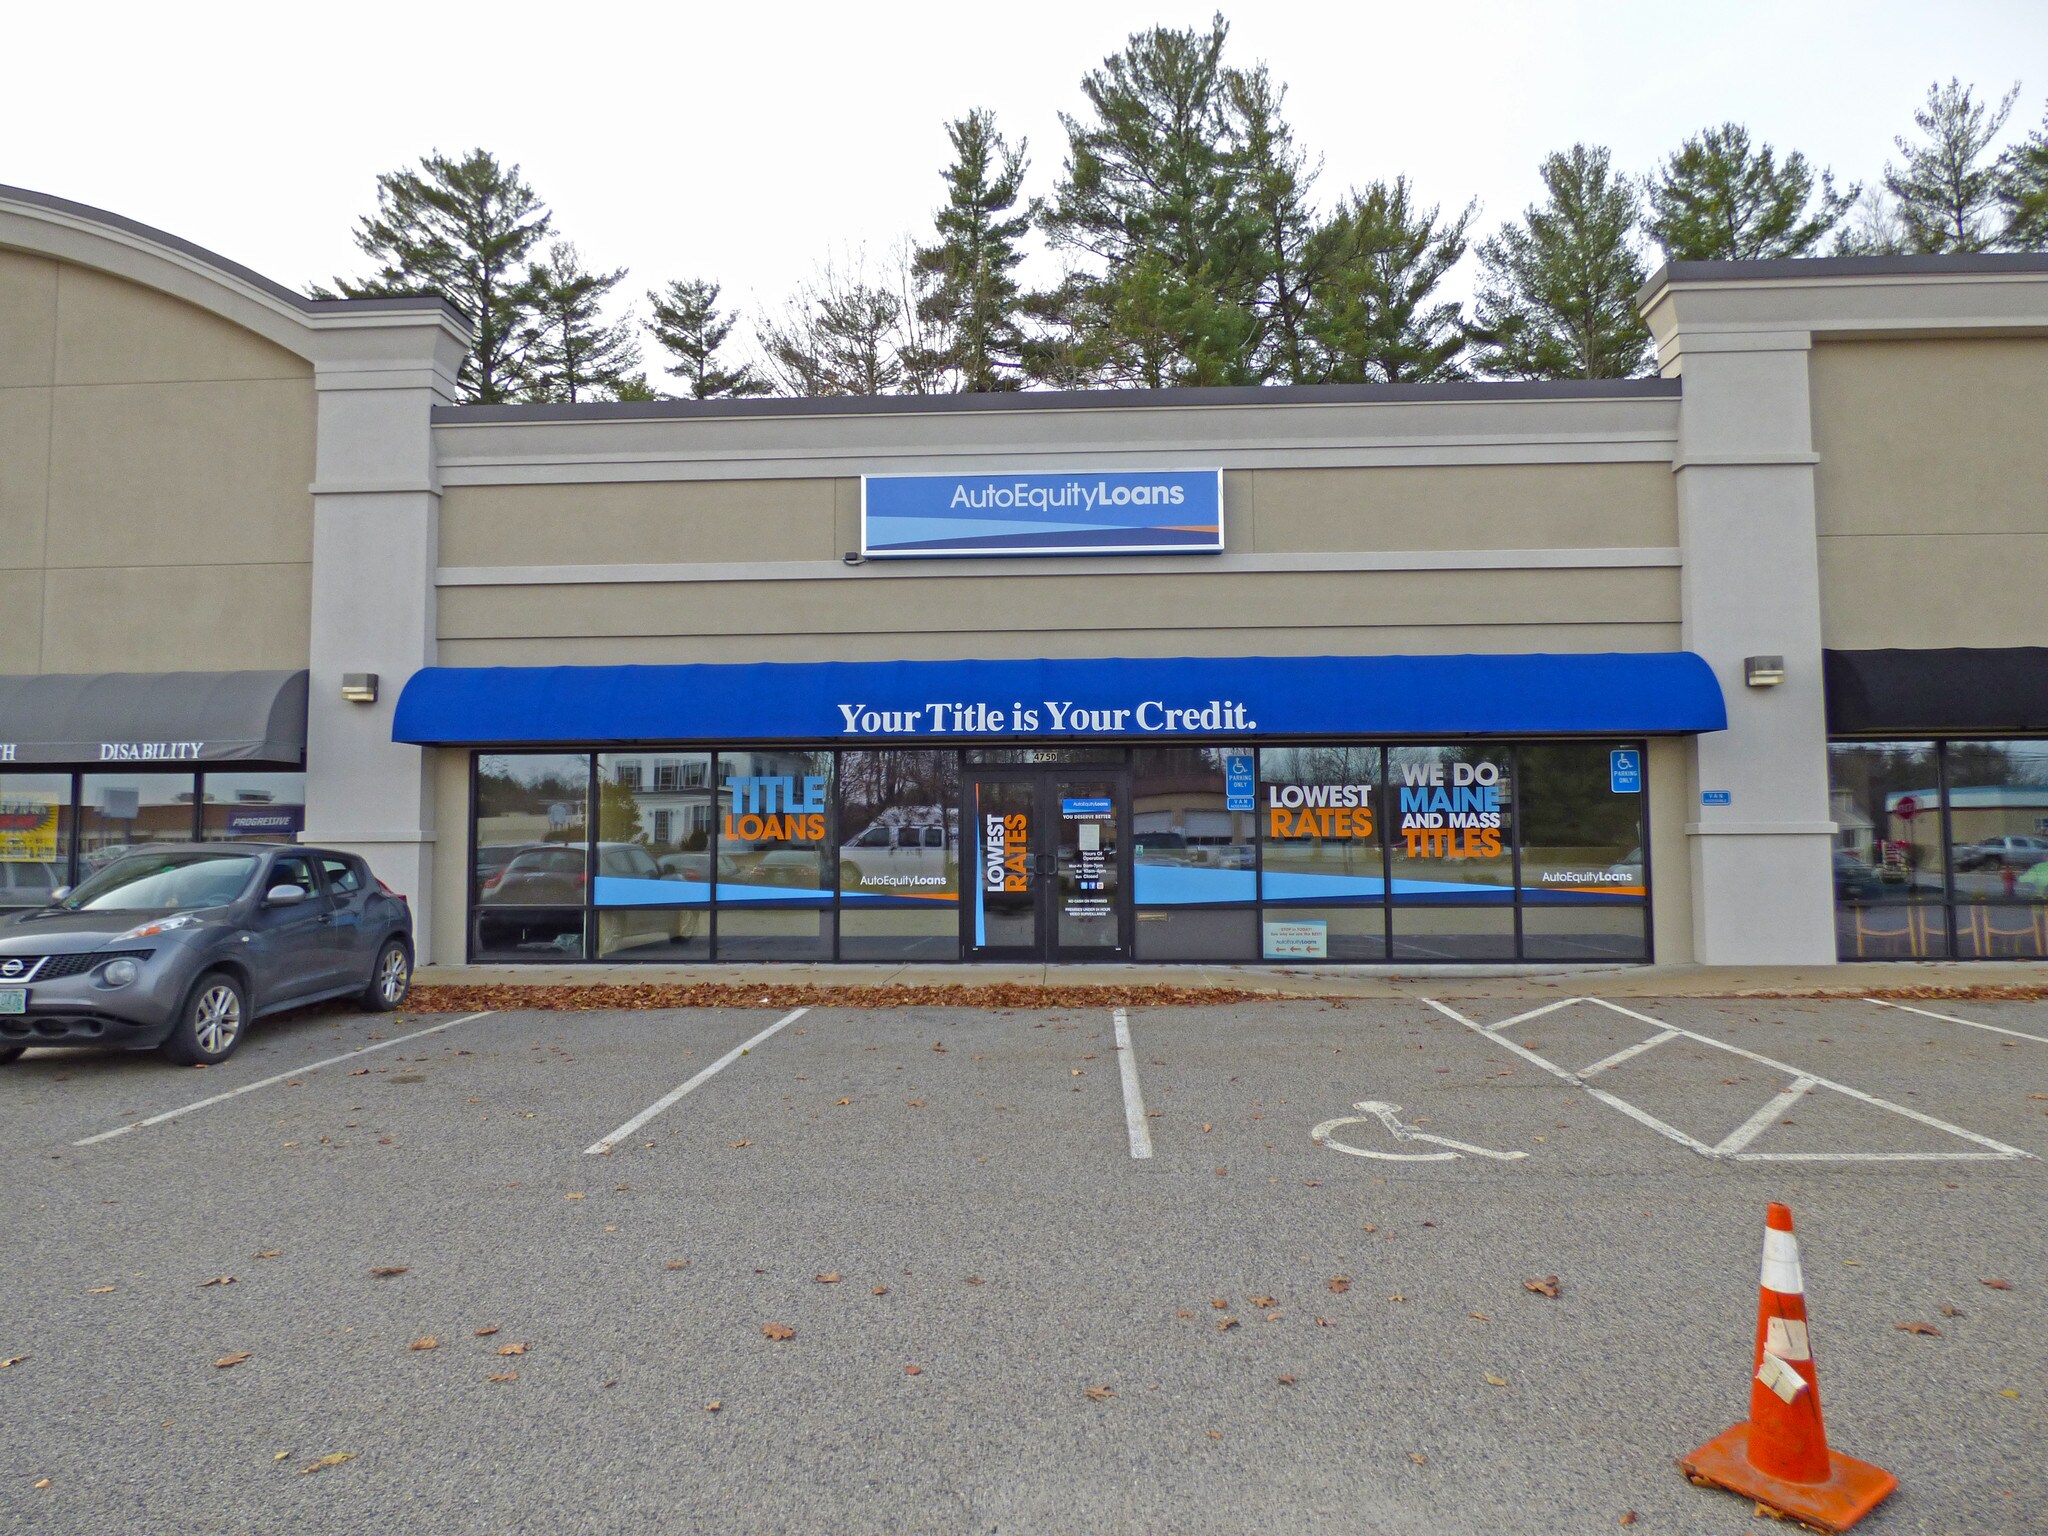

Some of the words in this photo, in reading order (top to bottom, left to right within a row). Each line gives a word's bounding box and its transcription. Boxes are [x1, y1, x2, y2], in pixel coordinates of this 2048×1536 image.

[950, 481, 1184, 512] AutoEquityLoans
[838, 704, 921, 733] Your
[926, 703, 1004, 732] Title
[1011, 702, 1039, 731] is
[1043, 702, 1130, 731] Your
[1136, 701, 1257, 731] Credit.
[0, 744, 17, 761] H
[100, 742, 204, 760] DISABILITY
[1034, 753, 1057, 761] 4750
[1401, 763, 1444, 787] WE
[1454, 762, 1499, 787] DO
[726, 776, 825, 814] TITLE
[1269, 785, 1372, 809] LOWEST
[1400, 787, 1500, 813] MAINE
[233, 816, 291, 827] PROGRESSIVE
[725, 814, 825, 841] LOANS
[1270, 807, 1373, 838] RATES
[1402, 813, 1443, 829] AND
[1450, 812, 1500, 829] MASS
[987, 814, 1005, 892] LOWEST
[1004, 813, 1027, 892] RATES
[1402, 829, 1501, 858] TITLES
[860, 875, 947, 888] AutoEquityLoans
[1542, 872, 1632, 883] AutoEquityLoans
